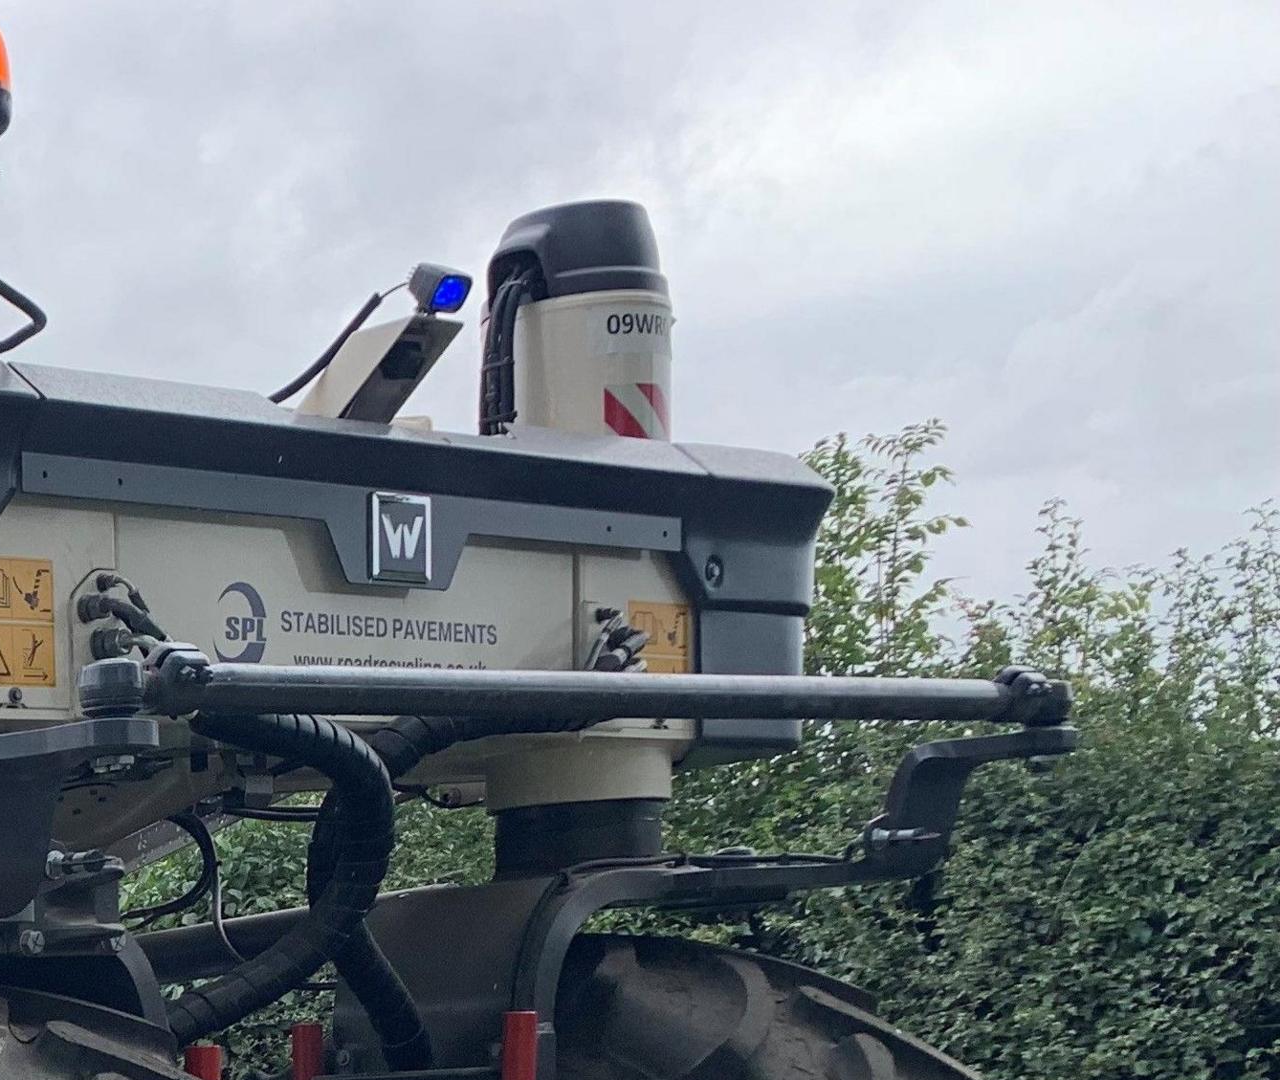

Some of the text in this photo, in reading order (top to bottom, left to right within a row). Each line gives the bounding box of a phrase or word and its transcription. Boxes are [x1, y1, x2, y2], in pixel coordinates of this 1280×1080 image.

[225, 616, 267, 642] SPL
[281, 610, 498, 646] STABILISED PAVEMENTS
